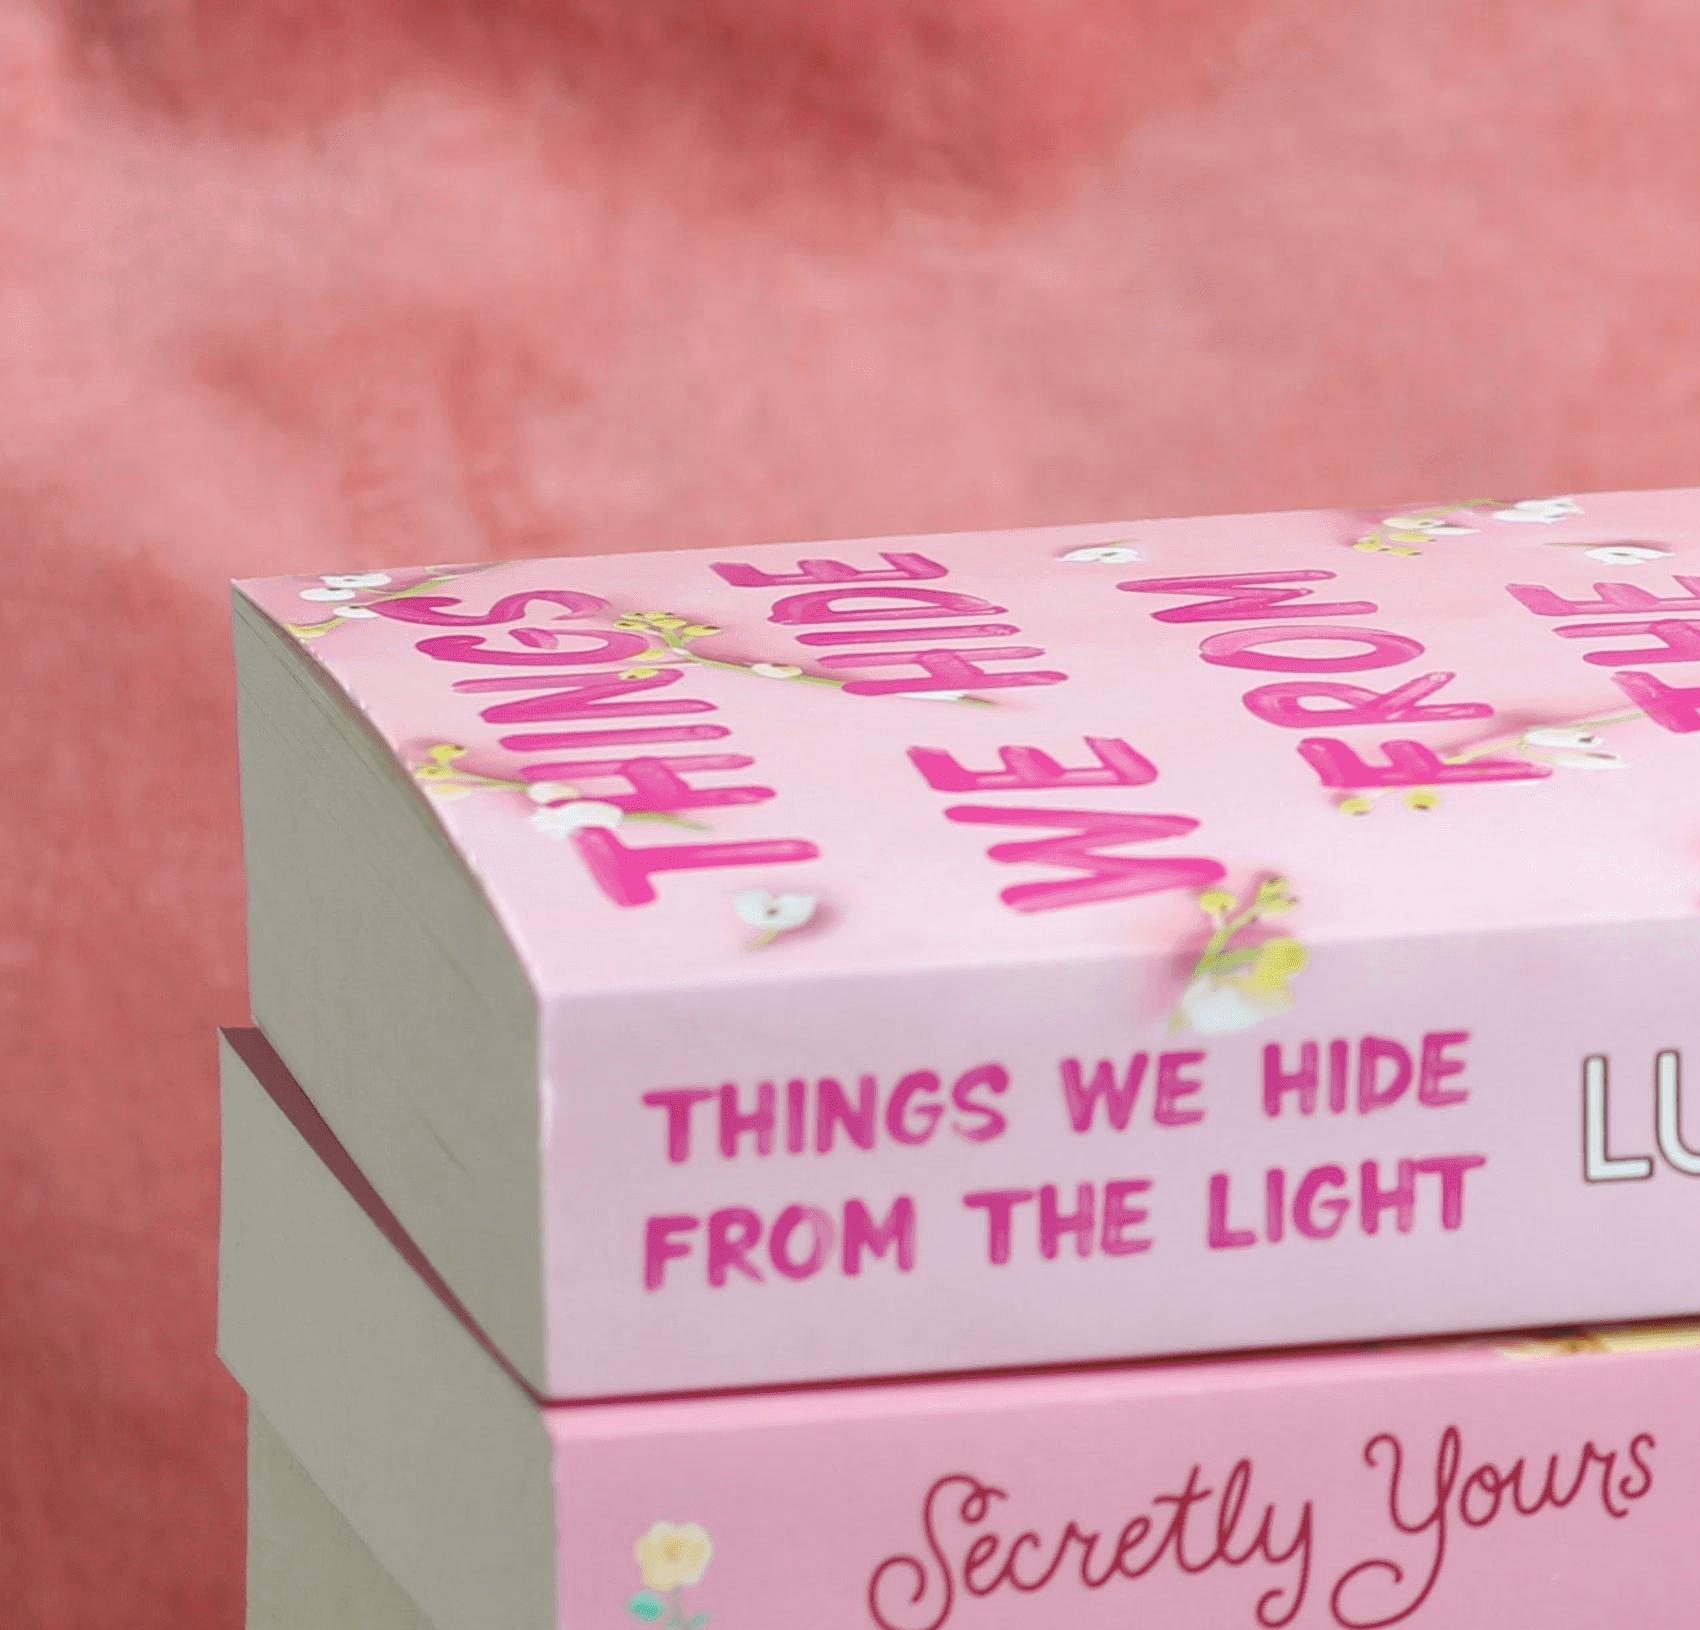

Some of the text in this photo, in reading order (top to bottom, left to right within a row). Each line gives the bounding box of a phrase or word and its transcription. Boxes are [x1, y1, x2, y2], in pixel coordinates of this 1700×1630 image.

[371, 589, 820, 909] THINGS
[710, 552, 1226, 914] WE HIDE
[1117, 569, 1553, 788] FROM
[642, 1030, 1472, 1165] THINGS WE HIDE
[643, 1155, 1487, 1292] FROM THE LIGHT
[1330, 1425, 1656, 1630] Yours
